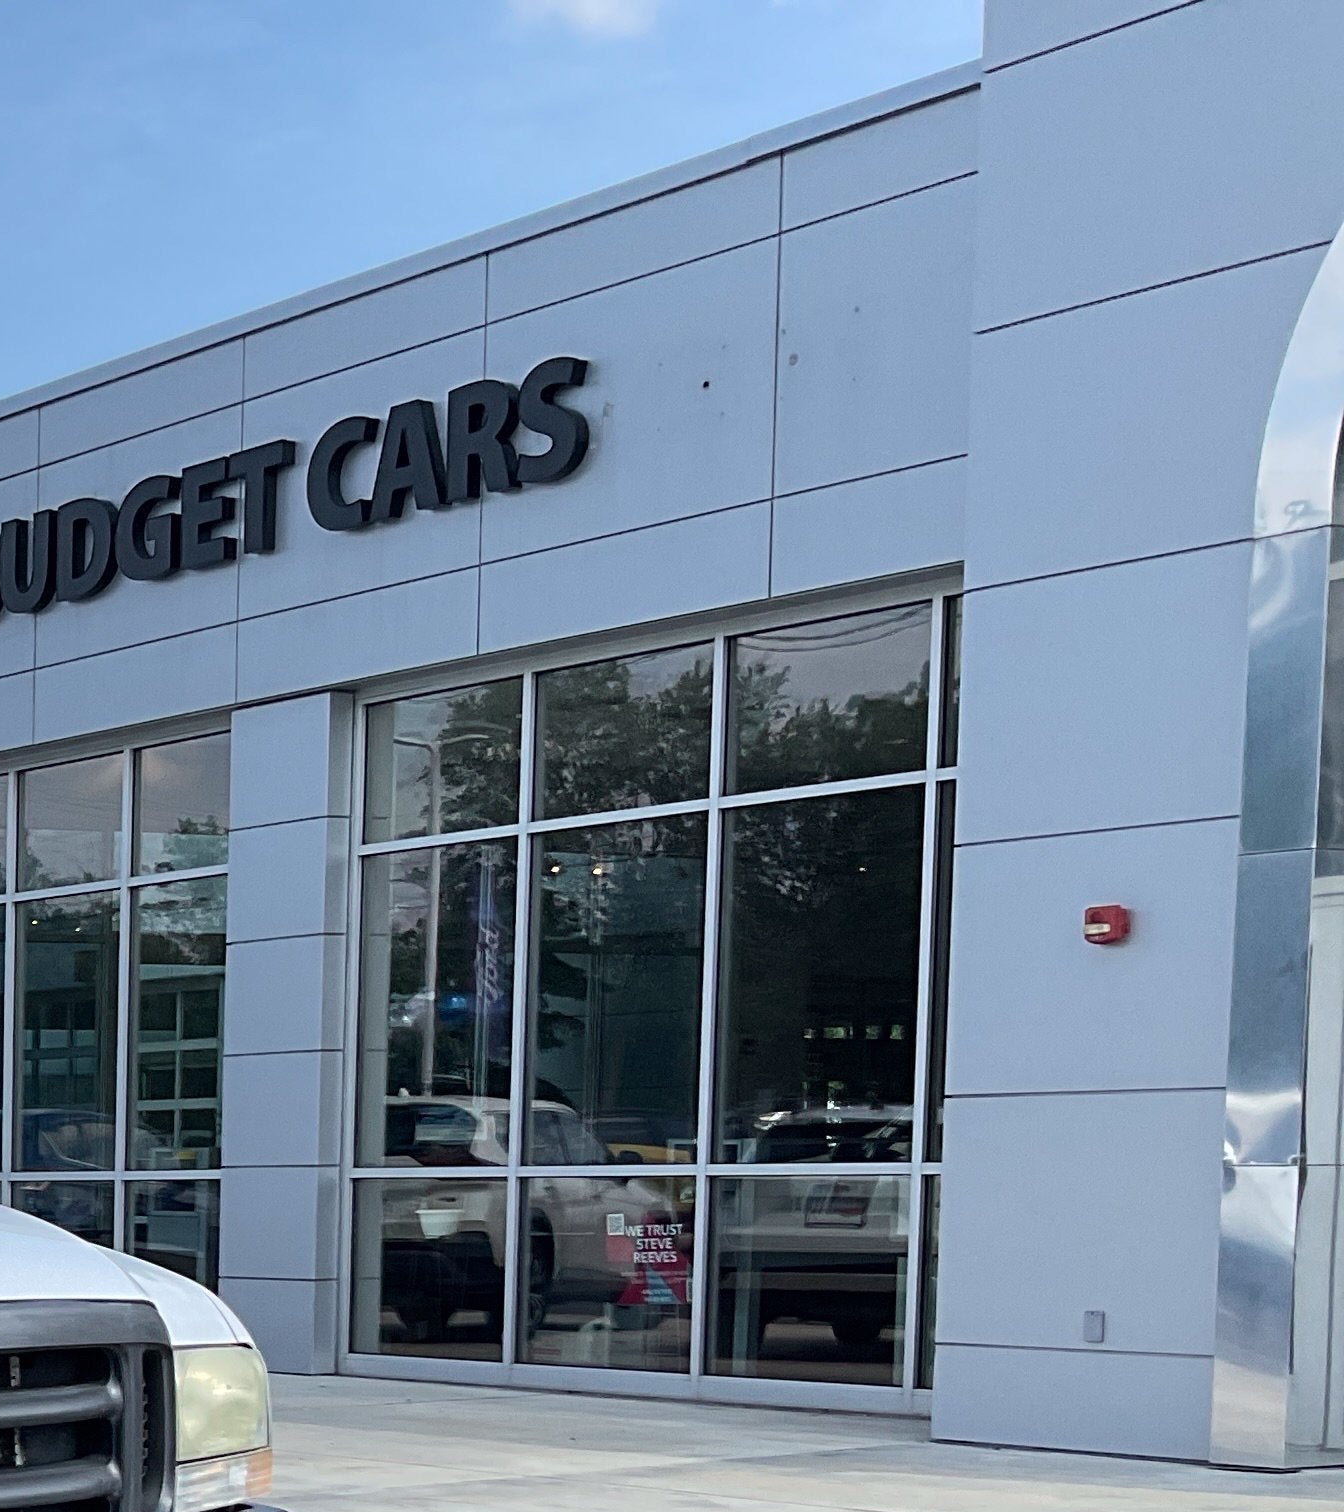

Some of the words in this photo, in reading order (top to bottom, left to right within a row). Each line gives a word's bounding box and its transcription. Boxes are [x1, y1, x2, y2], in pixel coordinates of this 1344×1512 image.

[307, 357, 589, 531] CARS
[625, 1225, 644, 1237] WE
[647, 1224, 683, 1237] TRUST
[636, 1237, 673, 1250] STEVE
[633, 1251, 678, 1263] REEVES
